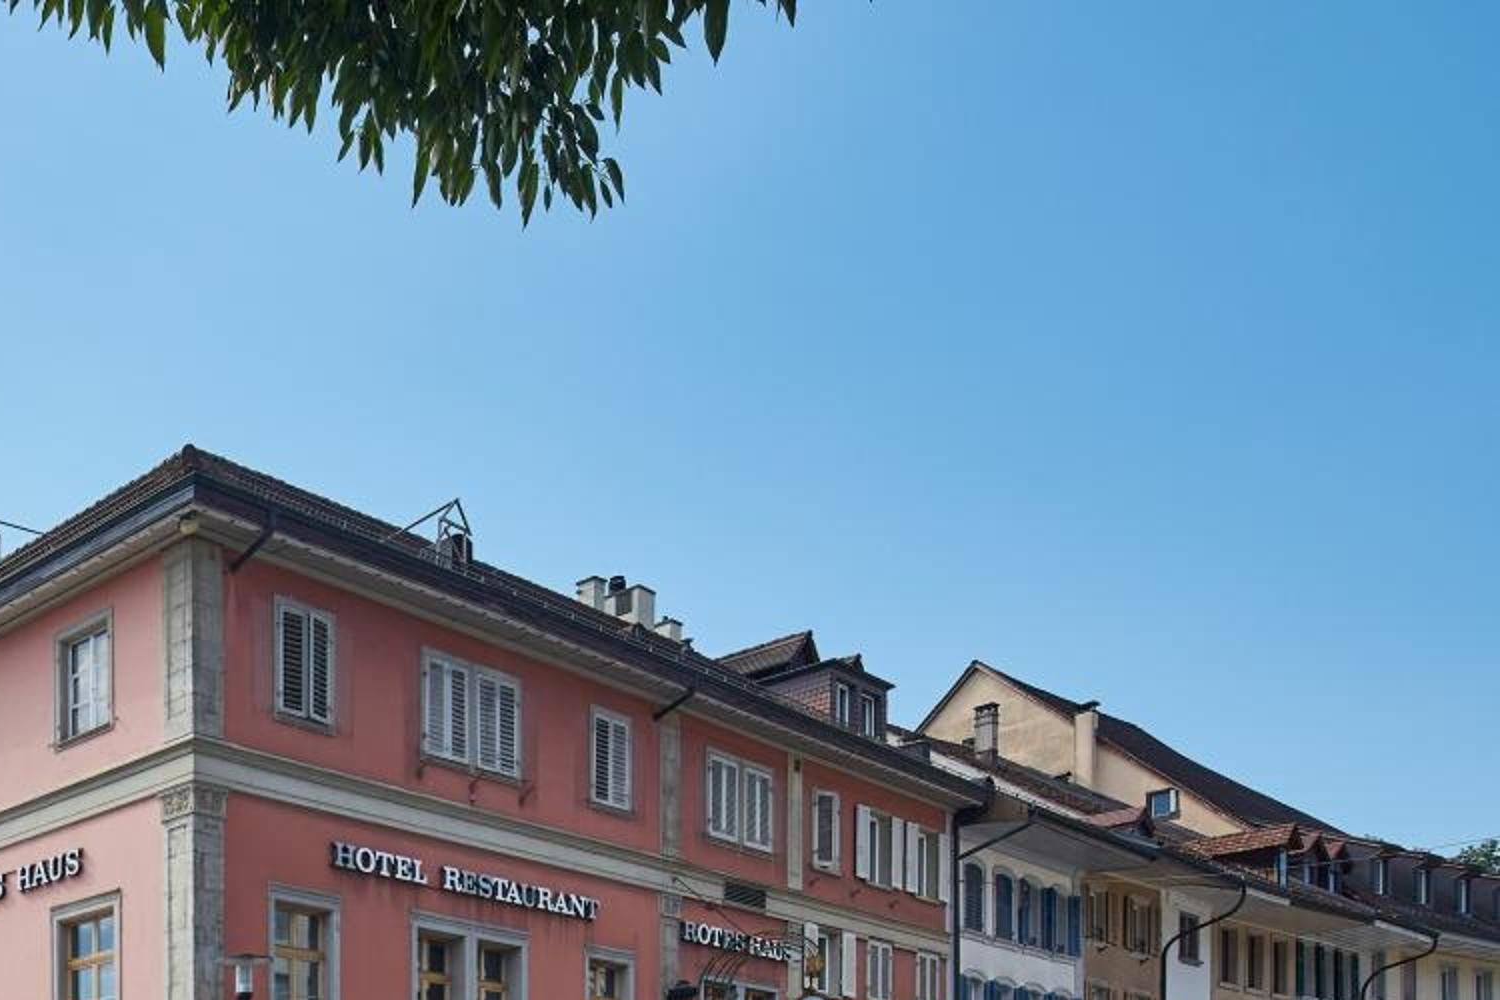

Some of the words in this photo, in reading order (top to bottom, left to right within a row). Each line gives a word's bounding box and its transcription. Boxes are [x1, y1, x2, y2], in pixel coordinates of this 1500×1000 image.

[17, 848, 83, 892] HAUS
[332, 841, 428, 884] HOTEL
[442, 865, 600, 921] RESTAURANT
[683, 920, 746, 952] ROTES
